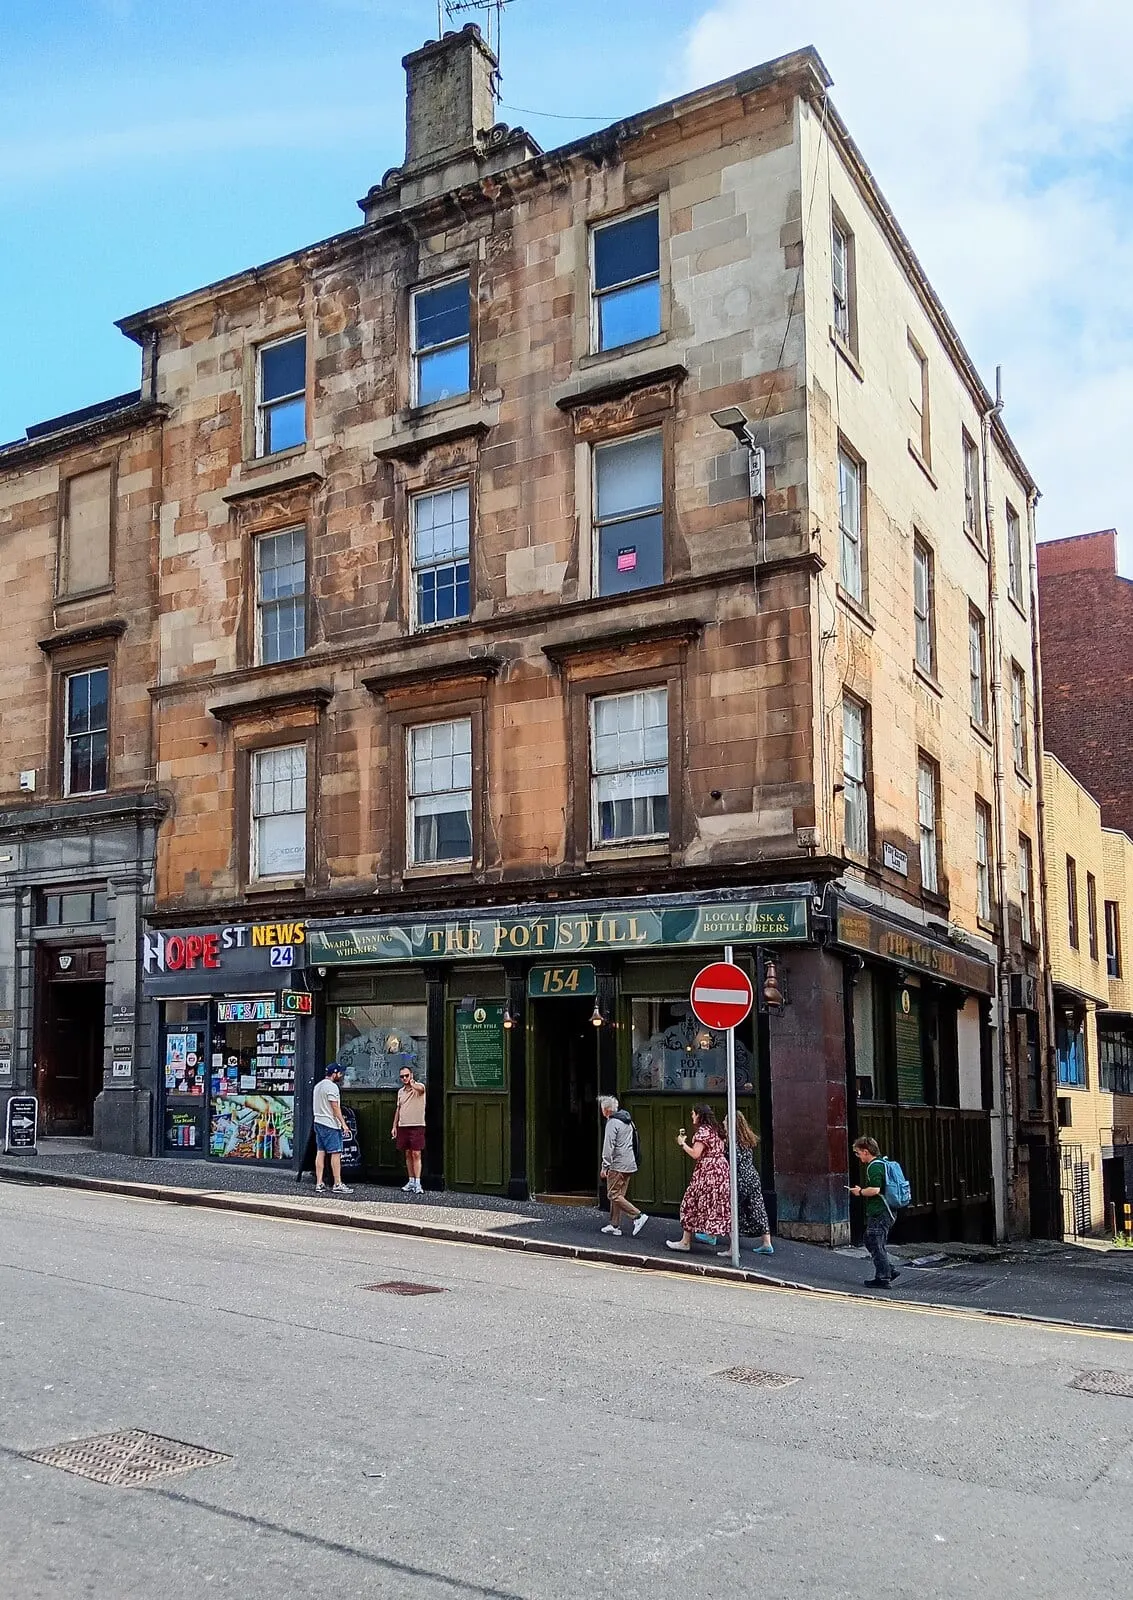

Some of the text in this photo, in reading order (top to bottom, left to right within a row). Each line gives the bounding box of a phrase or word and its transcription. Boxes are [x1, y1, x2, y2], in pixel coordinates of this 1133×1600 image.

[750, 469, 760, 477] 27
[705, 912, 785, 922] LOCAL CASK &
[428, 917, 648, 953] THE POT STILL
[703, 922, 789, 933] BOTTLED BEERS
[143, 923, 305, 973] HOPE ST NEWS
[322, 934, 393, 951] AWARD-WINNING
[271, 948, 292, 965] 24
[336, 944, 378, 957] WHISKIES
[542, 968, 579, 993] 154
[680, 1059, 702, 1068] POT
